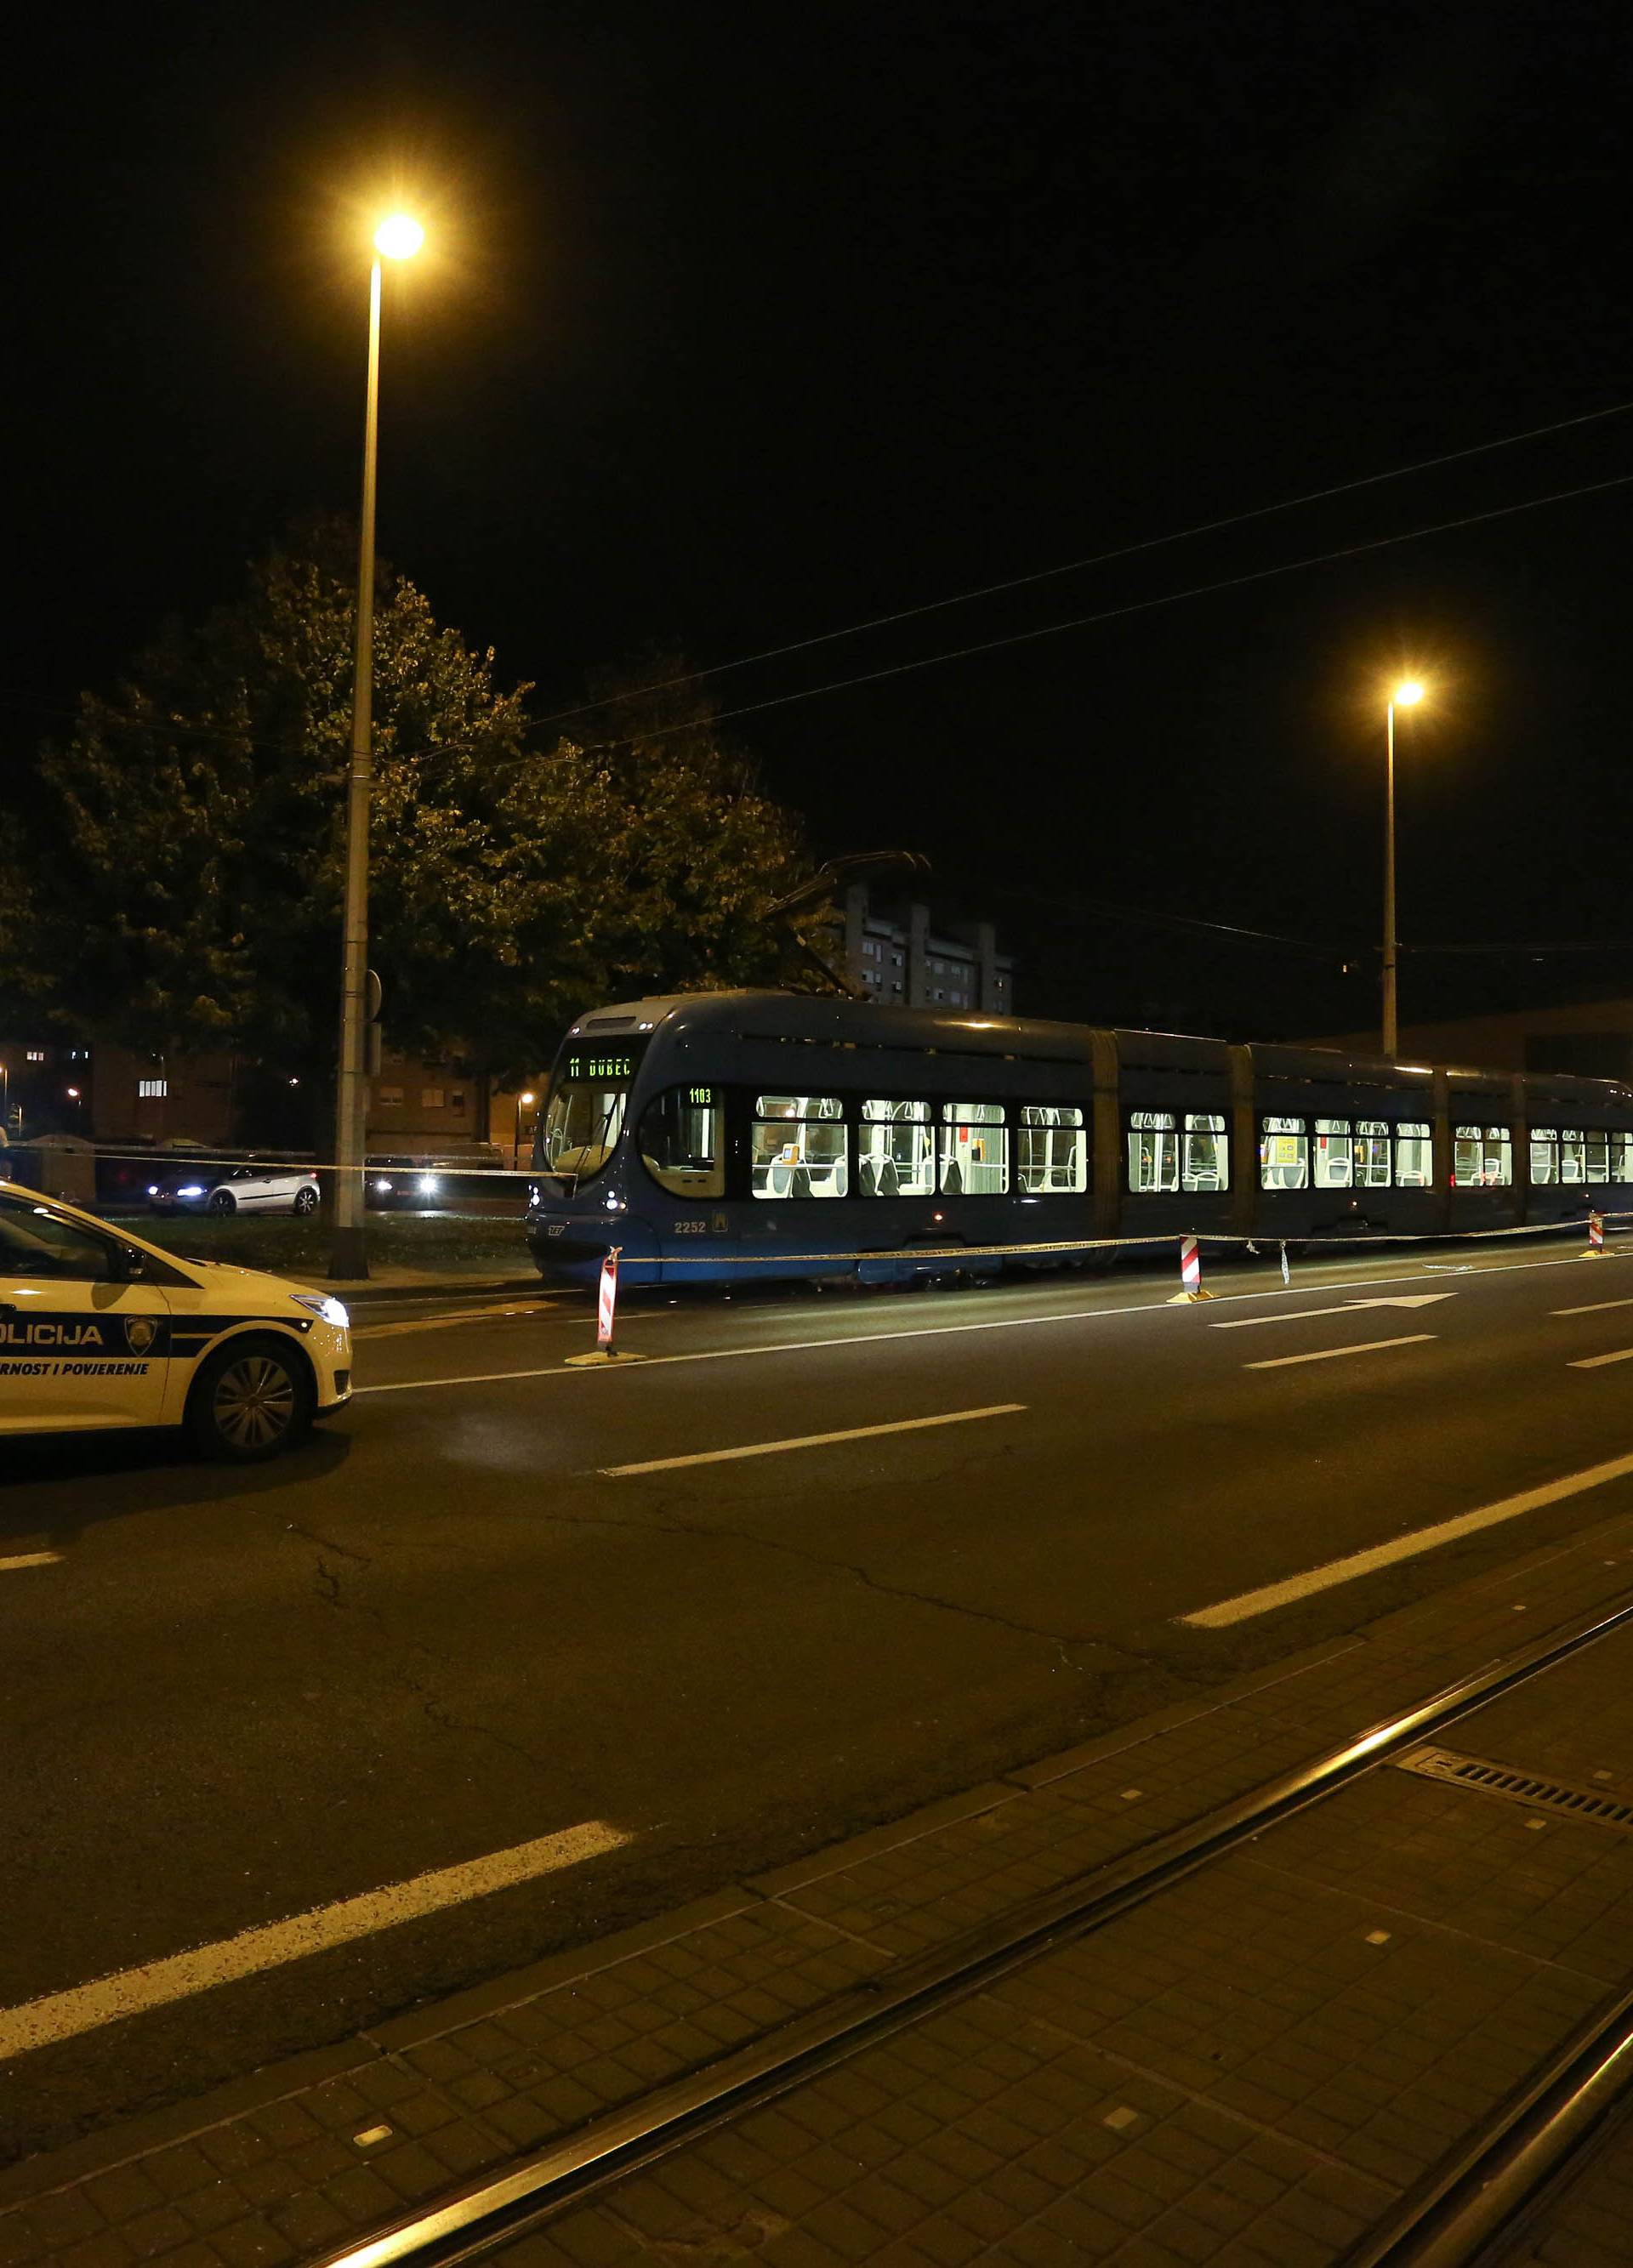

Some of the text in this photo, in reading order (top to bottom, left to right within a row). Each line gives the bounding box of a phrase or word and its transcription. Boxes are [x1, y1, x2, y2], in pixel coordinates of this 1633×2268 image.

[569, 1058, 580, 1077] 11
[689, 1088, 712, 1104] 1103
[674, 1221, 707, 1234] 2252
[53, 1363, 60, 1376] I
[62, 1362, 150, 1376] POVJERENJE
